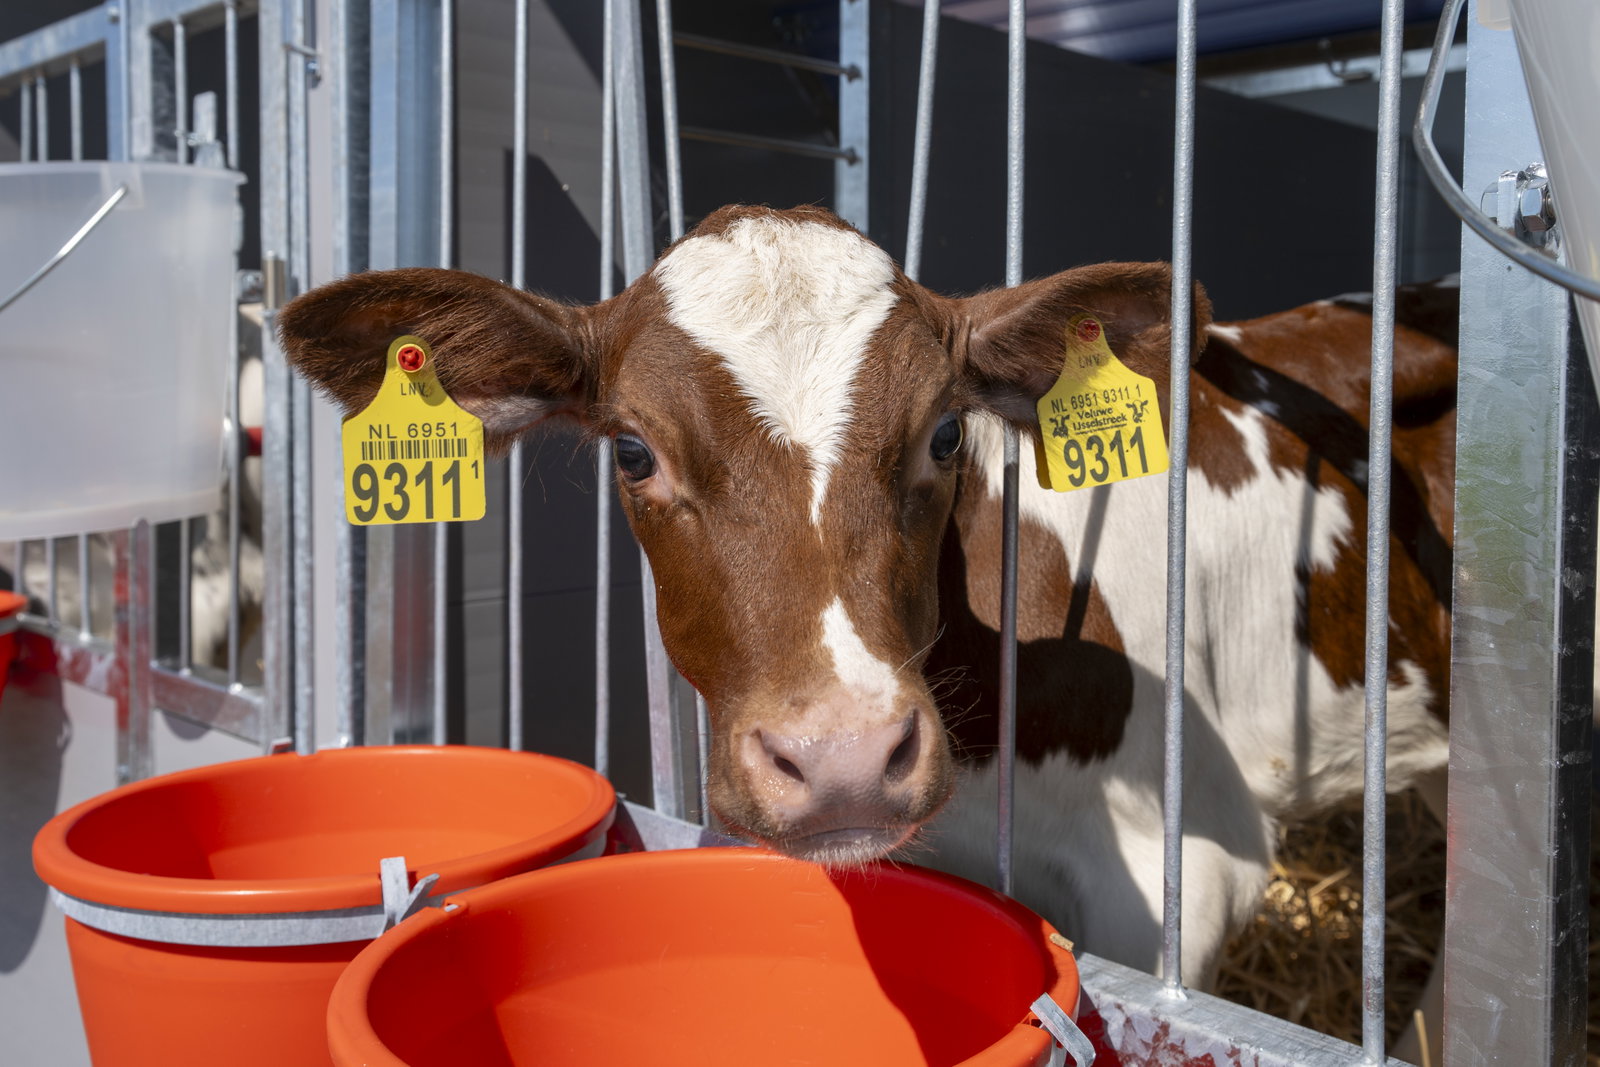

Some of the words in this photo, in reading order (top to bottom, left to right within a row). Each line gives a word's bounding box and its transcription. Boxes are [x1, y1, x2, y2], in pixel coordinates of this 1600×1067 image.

[1050, 398, 1068, 414] NL
[1070, 392, 1098, 410] 6951
[1103, 386, 1130, 404] 9311
[1135, 384, 1142, 398] 1
[1072, 413, 1128, 431] IJsselstreek
[1076, 407, 1114, 420] Veluwe
[369, 424, 397, 439] NL
[407, 422, 458, 438] 6951
[1063, 426, 1149, 487] 9311
[351, 460, 461, 522] 9311
[471, 460, 479, 479] 1
